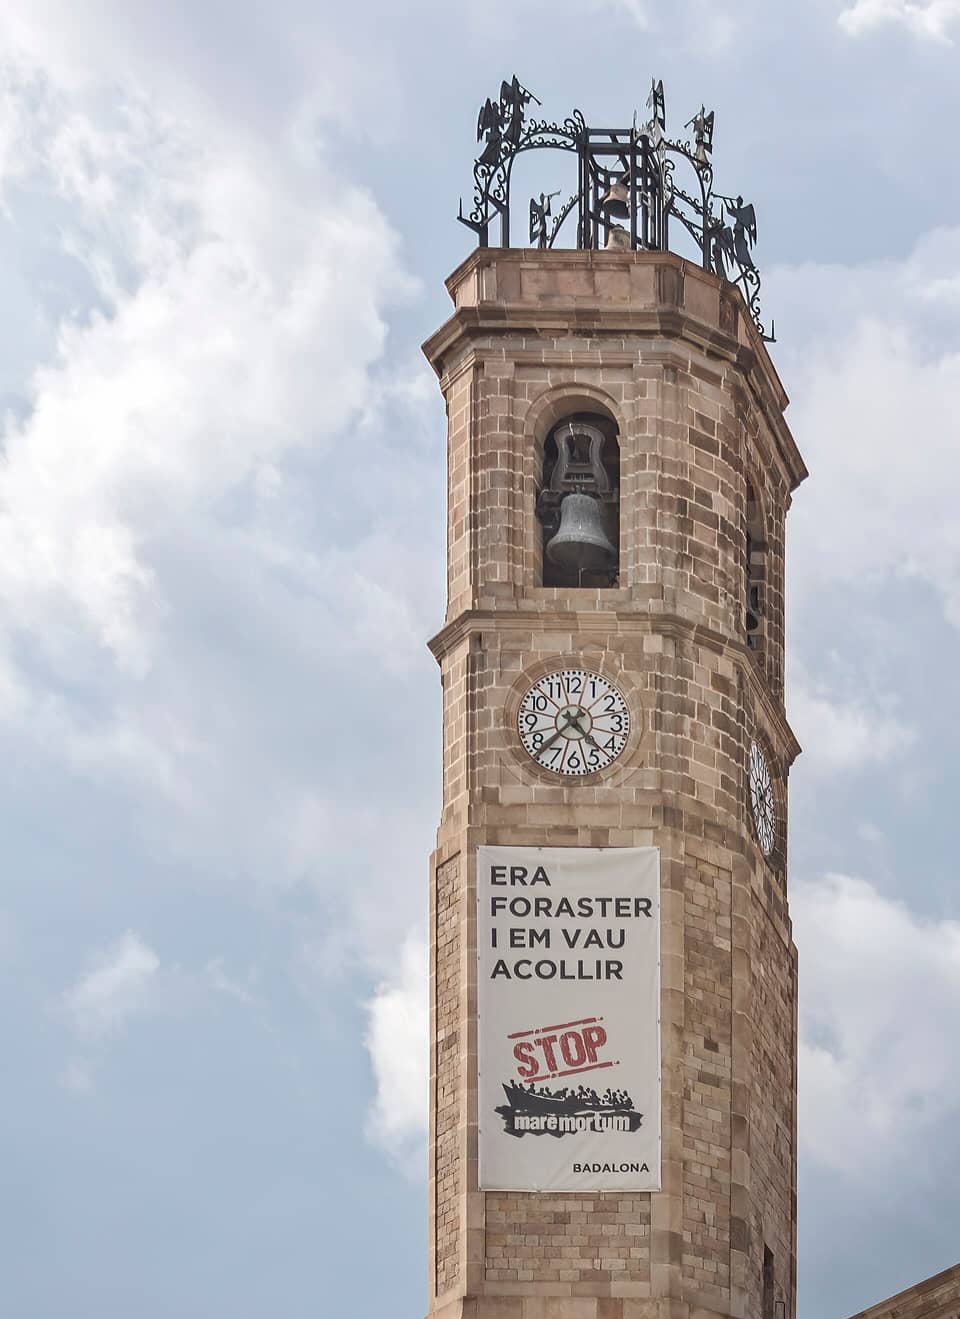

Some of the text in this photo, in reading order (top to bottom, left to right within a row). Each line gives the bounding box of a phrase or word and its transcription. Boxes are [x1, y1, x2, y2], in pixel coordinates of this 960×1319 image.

[547, 682, 561, 699] 11
[566, 677, 582, 694] 12
[590, 681, 596, 699] 1
[531, 695, 548, 712] 10
[603, 695, 616, 712] 2
[524, 713, 538, 732] 9
[610, 715, 623, 732] 3
[531, 733, 544, 750] 8
[603, 736, 616, 752] 4
[549, 747, 562, 765] 7
[567, 750, 581, 769] 6
[587, 749, 600, 766] 5
[490, 866, 552, 886] ERA
[490, 897, 653, 918] FORASTER
[491, 928, 626, 949] I EM VAU
[490, 959, 623, 980] ACOLLIR
[512, 1024, 608, 1078] STOP
[573, 1163, 649, 1173] BADALONA
